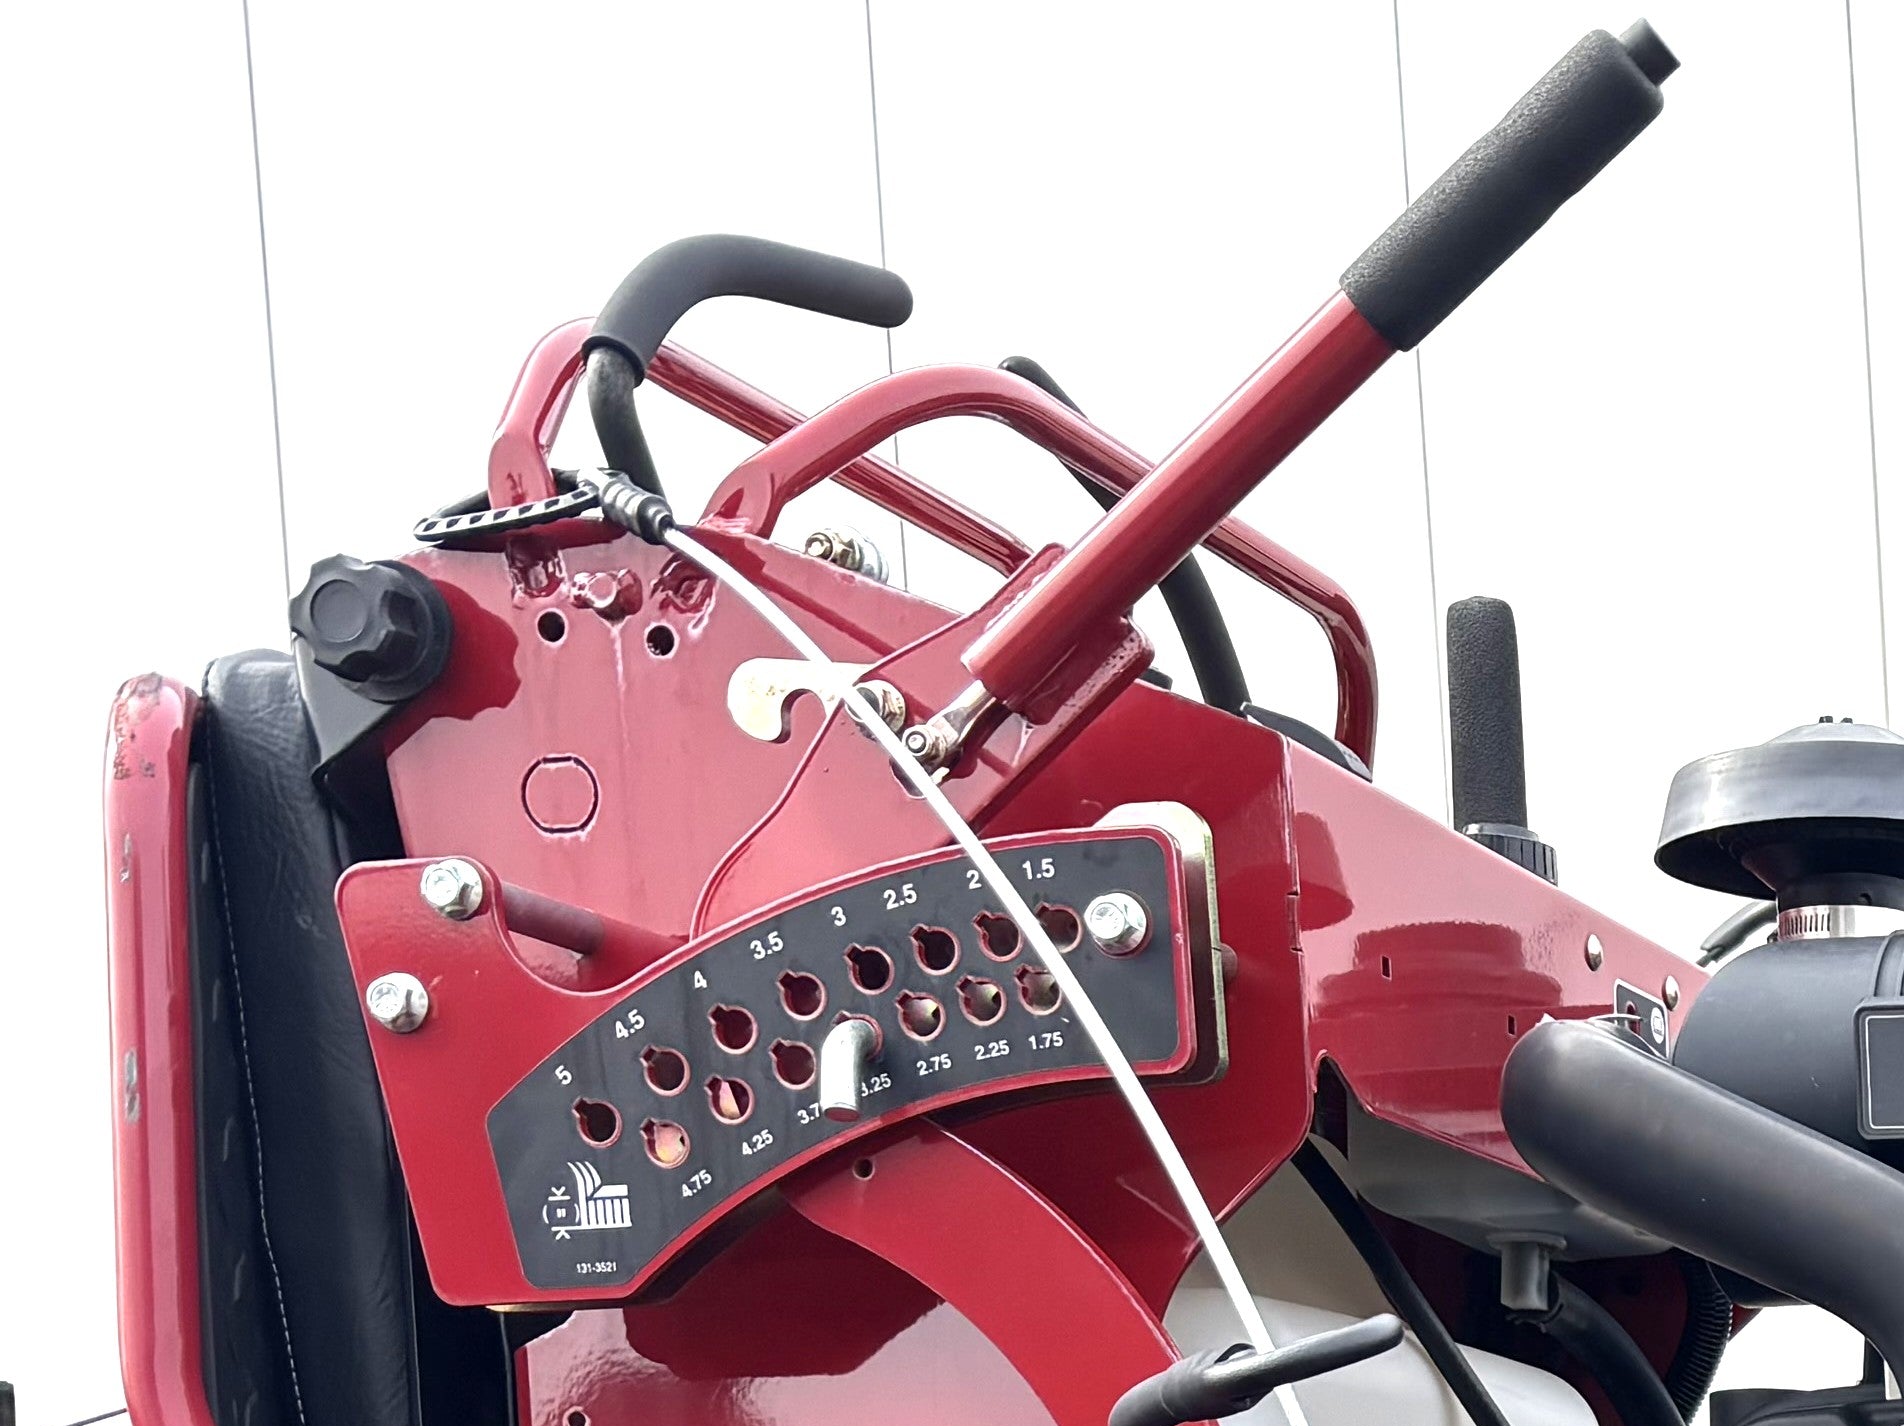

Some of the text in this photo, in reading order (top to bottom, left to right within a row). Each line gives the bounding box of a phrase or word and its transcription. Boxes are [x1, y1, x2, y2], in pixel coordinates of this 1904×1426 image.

[555, 858, 1055, 1085] 5 4.5 4 3.5 3 2.5 2 1.5
[682, 1169, 712, 1197] 4.75
[741, 1129, 774, 1156] 4.25
[797, 1103, 822, 1125] 3.7
[917, 1053, 951, 1076] 2.75
[975, 1040, 1009, 1061] 2.25
[1028, 1031, 1063, 1052] 1.75
[576, 1261, 617, 1274] 131-3521
